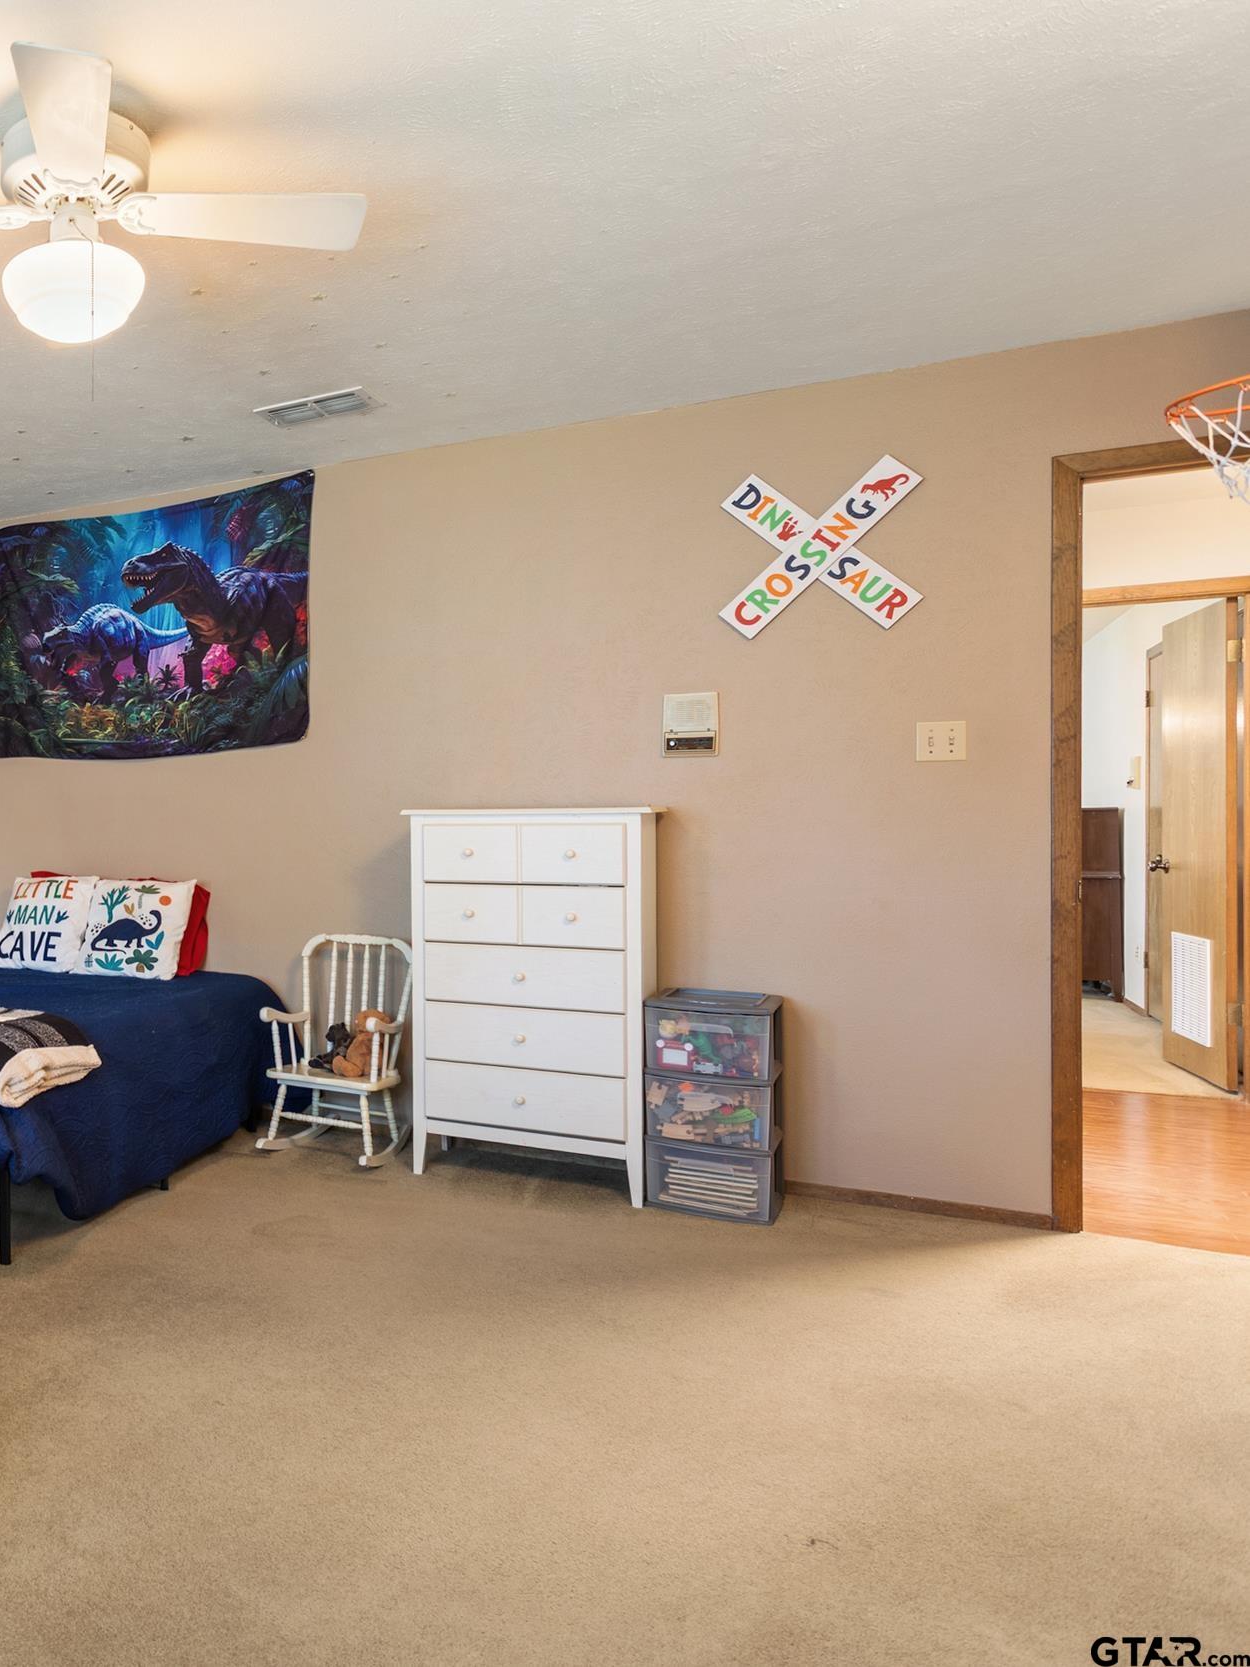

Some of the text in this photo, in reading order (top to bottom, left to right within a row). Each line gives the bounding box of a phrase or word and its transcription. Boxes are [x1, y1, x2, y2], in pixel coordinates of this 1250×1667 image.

[735, 498, 877, 626] CROSSING
[827, 557, 908, 620] SAUR
[14, 879, 79, 900] LITTLE
[13, 904, 57, 926] MAN
